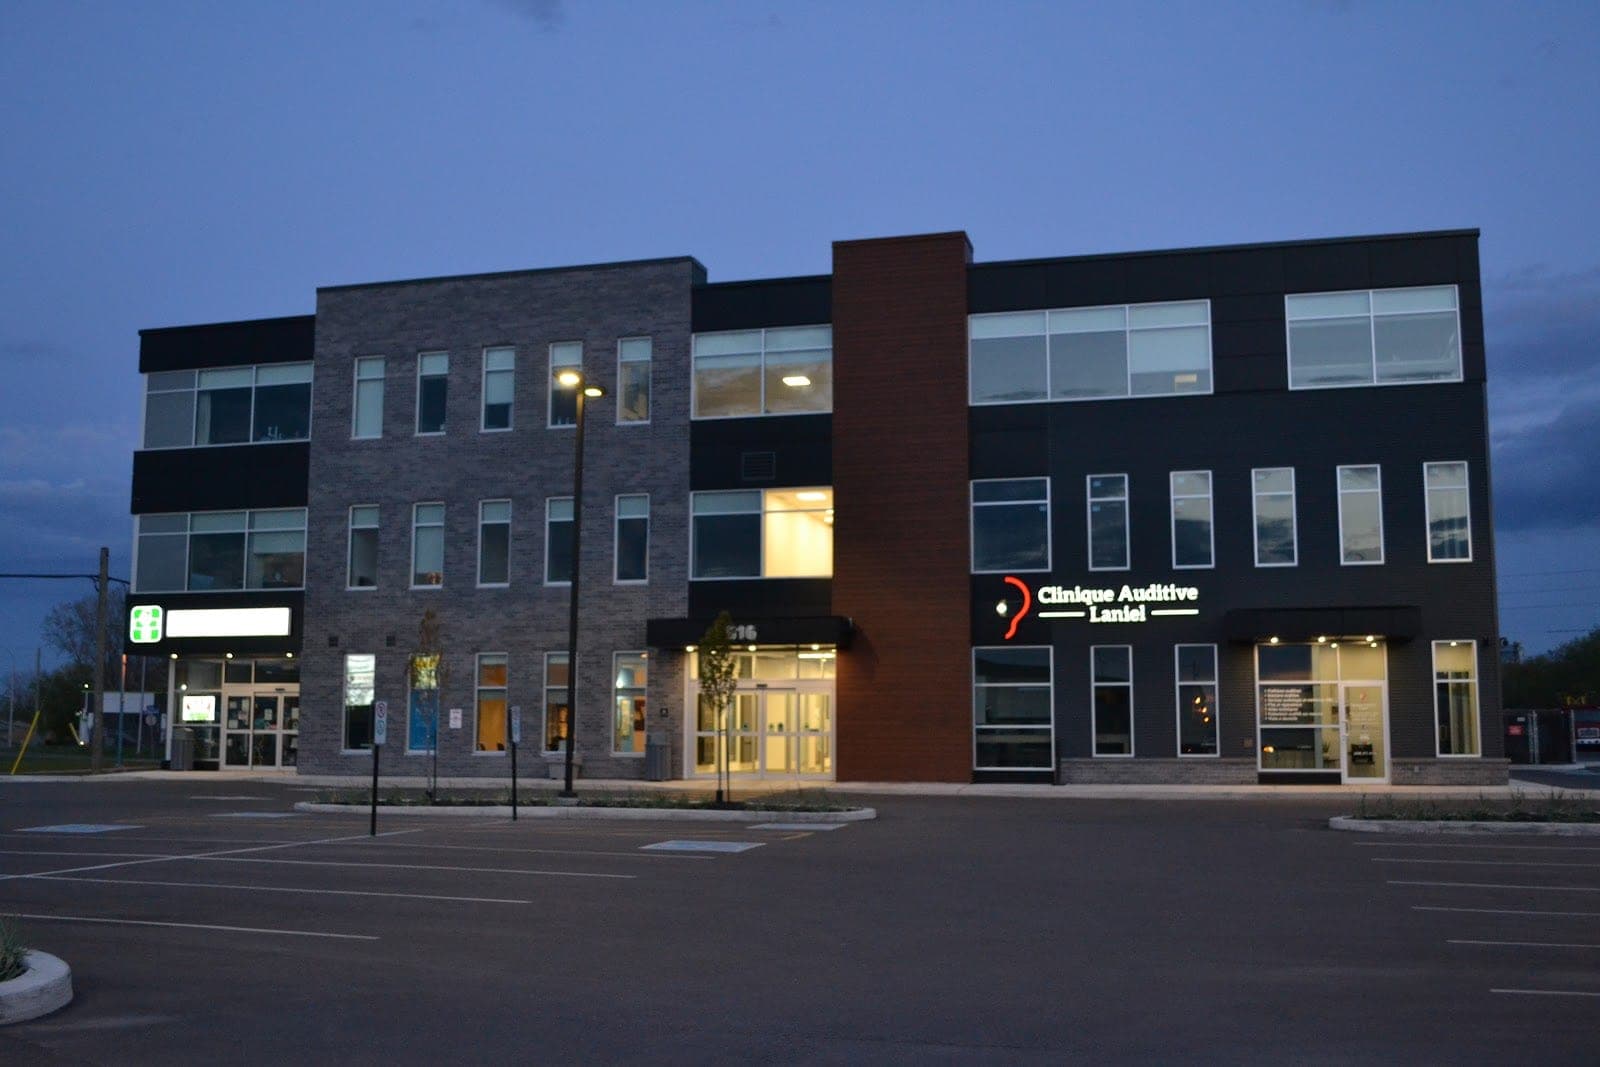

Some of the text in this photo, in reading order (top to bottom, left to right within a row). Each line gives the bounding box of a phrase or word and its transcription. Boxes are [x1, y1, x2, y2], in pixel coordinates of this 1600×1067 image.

[1038, 584, 1198, 605] Clinique Auditive
[1090, 605, 1147, 622] Laniel
